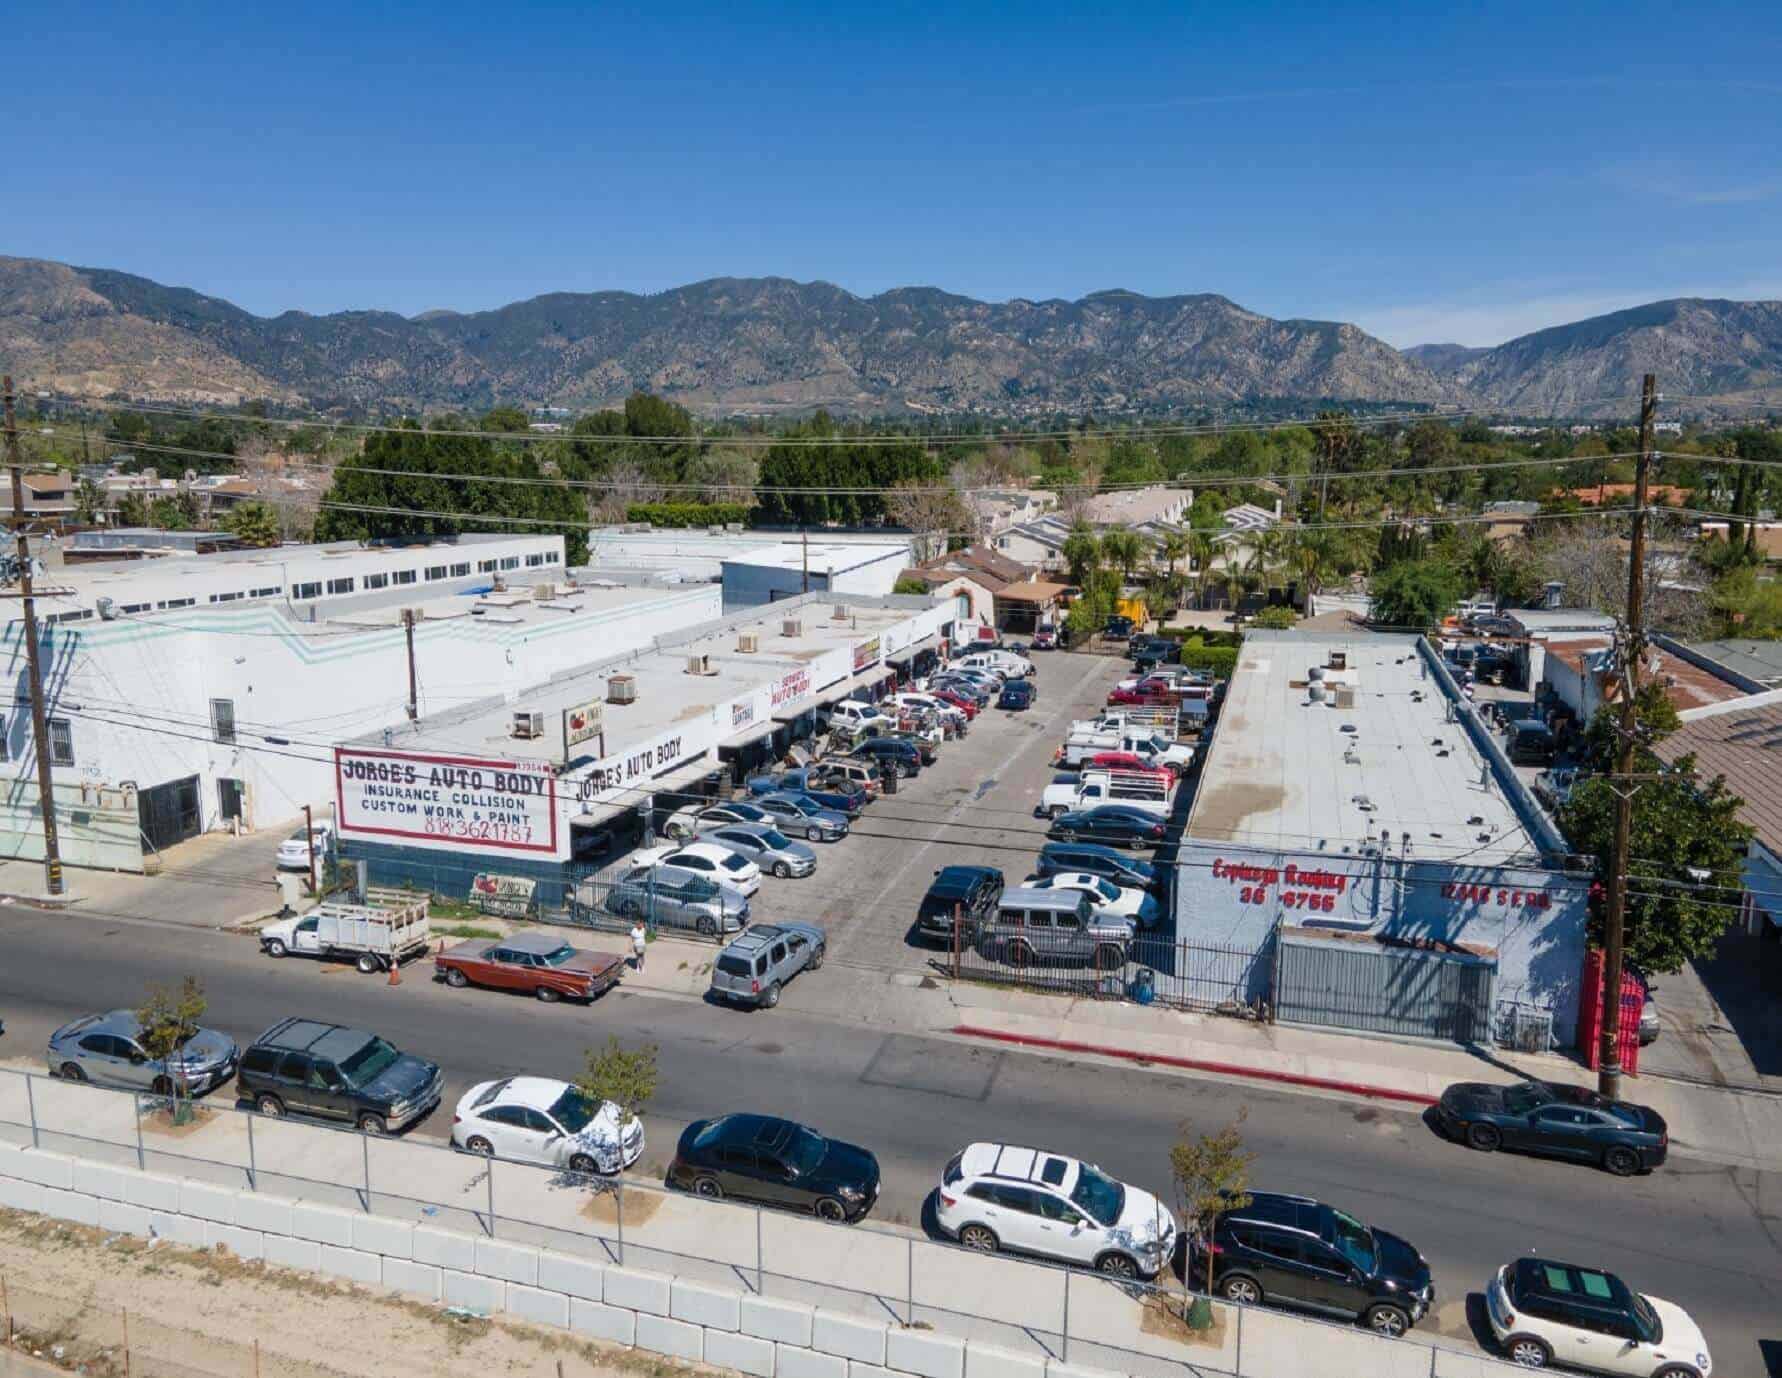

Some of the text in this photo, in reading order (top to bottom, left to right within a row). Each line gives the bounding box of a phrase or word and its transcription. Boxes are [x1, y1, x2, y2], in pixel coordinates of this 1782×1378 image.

[627, 751, 653, 780] AUTO
[657, 736, 682, 764] BODY
[430, 768, 482, 790] AUTO
[494, 771, 545, 796] BODY
[364, 784, 525, 810] INSURANCE COLLISION
[362, 800, 530, 826] CUSTOM WORK & PAINT
